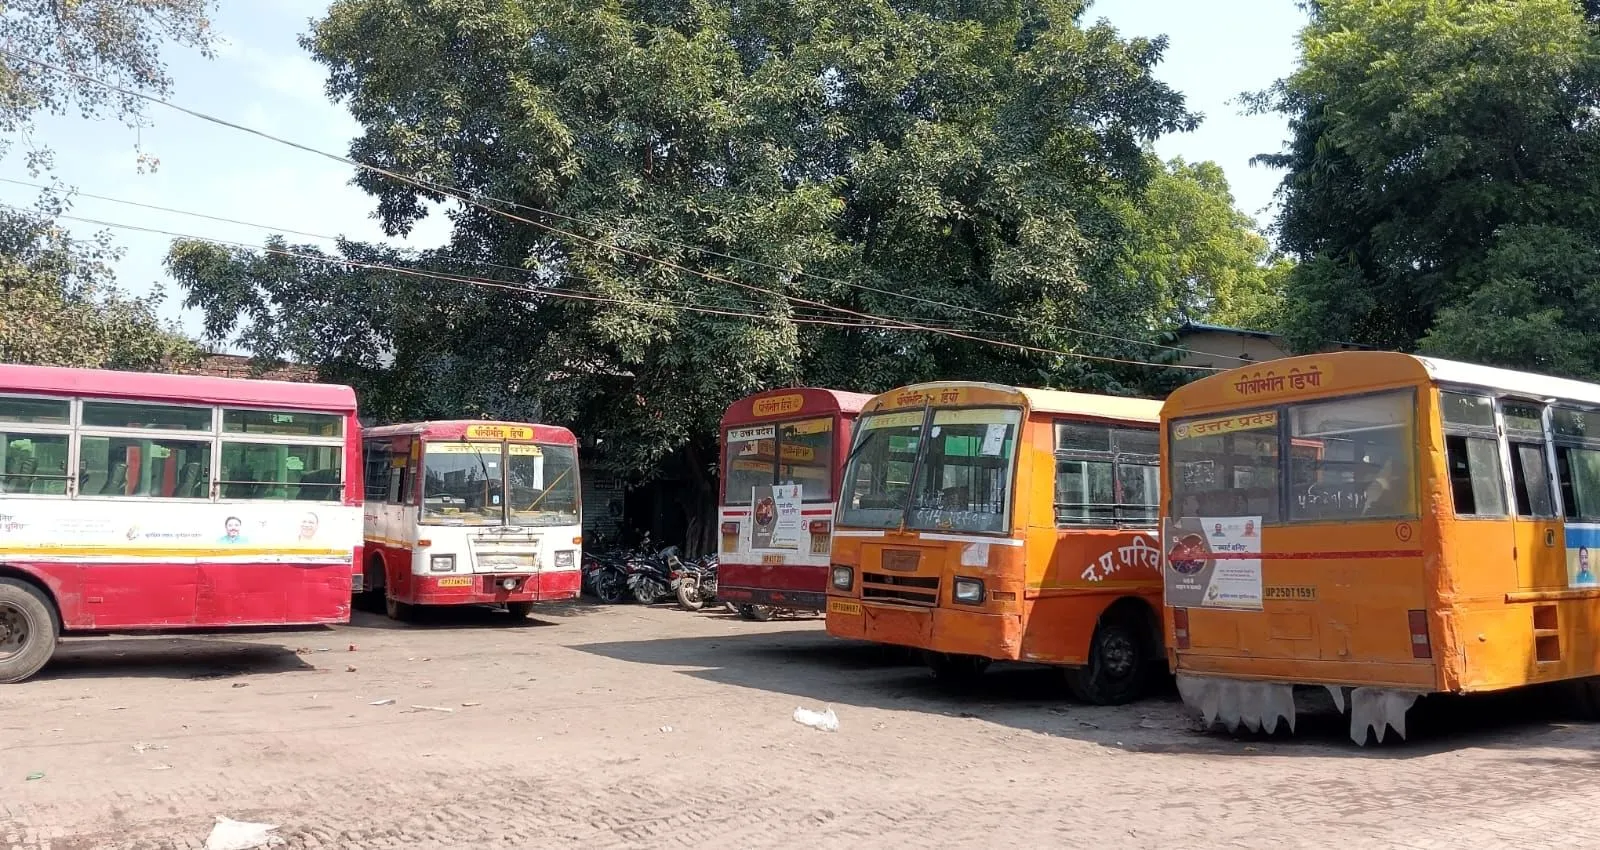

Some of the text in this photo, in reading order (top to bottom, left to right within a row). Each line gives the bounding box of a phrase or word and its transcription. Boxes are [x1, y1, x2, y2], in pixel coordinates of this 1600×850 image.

[1234, 366, 1323, 395] पीलीभीत डिपो
[1193, 412, 1277, 434] उत्तर प्रदेश
[740, 428, 754, 438] उत्तर
[1265, 587, 1316, 599] UP25DT1591
